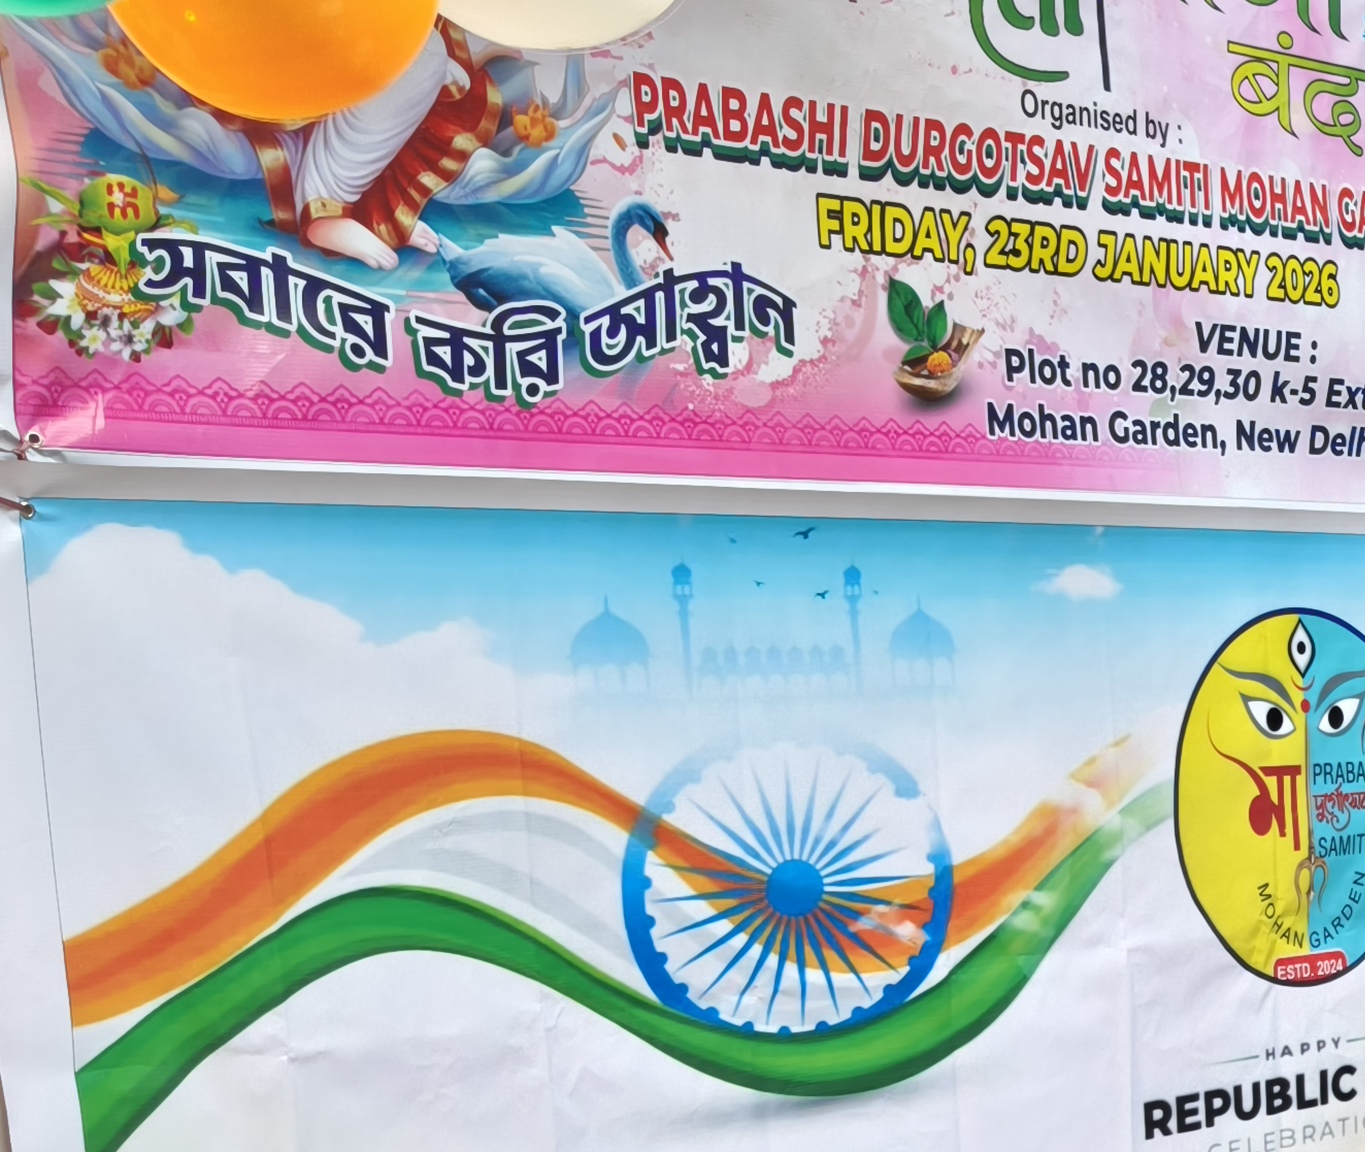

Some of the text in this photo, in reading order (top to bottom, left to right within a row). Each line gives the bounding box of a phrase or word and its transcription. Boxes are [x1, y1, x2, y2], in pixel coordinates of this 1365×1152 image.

[1020, 89, 1139, 137] Organised
[1145, 110, 1169, 148] by
[630, 69, 850, 172] PRABASHI
[859, 107, 1097, 203] DURGOTSAV
[1102, 144, 1213, 220] SAMITI
[1219, 165, 1332, 238] MOHAN
[816, 192, 1341, 308] FRIDAY, 23RD JANUARY 2026
[138, 237, 798, 402] সবারে করি আহ্বান
[1194, 320, 1302, 363] VENUE
[1004, 347, 1072, 388] Plot
[1082, 360, 1122, 391] no
[1131, 358, 1262, 405] 28,29,30
[1270, 371, 1318, 406] k-5
[987, 402, 1100, 444] Mohan
[1108, 410, 1226, 456] Garden,
[1236, 419, 1302, 454] New
[1256, 882, 1305, 949] MOHAN
[1276, 957, 1344, 981] ESTD. 2024
[1264, 1036, 1342, 1061] HAPPY
[1143, 1065, 1358, 1141] REPUBLIC
